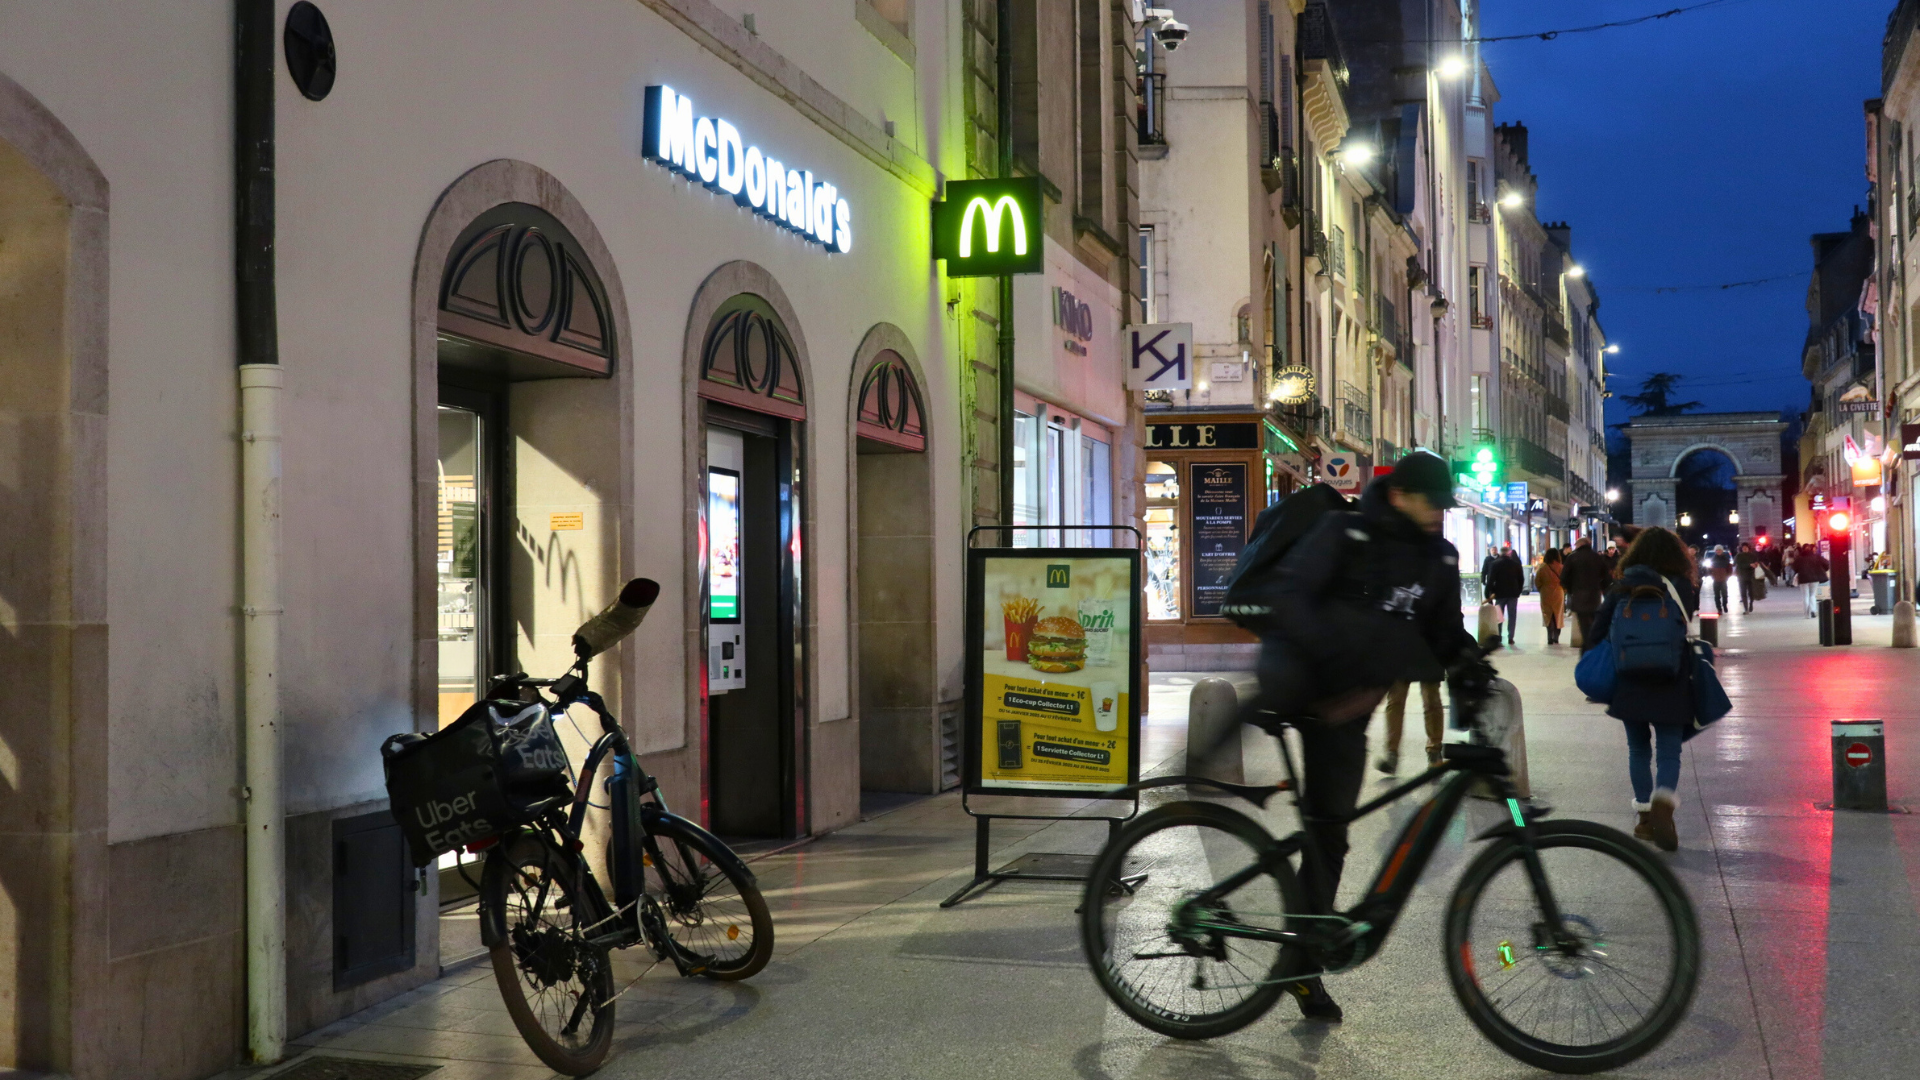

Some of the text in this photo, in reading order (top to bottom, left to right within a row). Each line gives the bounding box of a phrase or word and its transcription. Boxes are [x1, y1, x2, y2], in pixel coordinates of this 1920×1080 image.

[657, 84, 852, 254] McDonald's
[1839, 402, 1878, 412] LA CIVETTE
[1145, 425, 1217, 447] LLE
[1012, 697, 1037, 706] Eco-cup
[1037, 700, 1066, 709] Collector
[1043, 687, 1054, 696] d'un
[1077, 690, 1086, 700] 1€
[1033, 732, 1045, 740] Pour
[1072, 736, 1084, 745] d'un
[1107, 740, 1117, 749] 2€
[515, 743, 566, 769] Eats
[1041, 745, 1068, 755] Serviette
[1068, 749, 1096, 759] Collector
[415, 790, 477, 829] Uber
[425, 818, 493, 852] Eats
